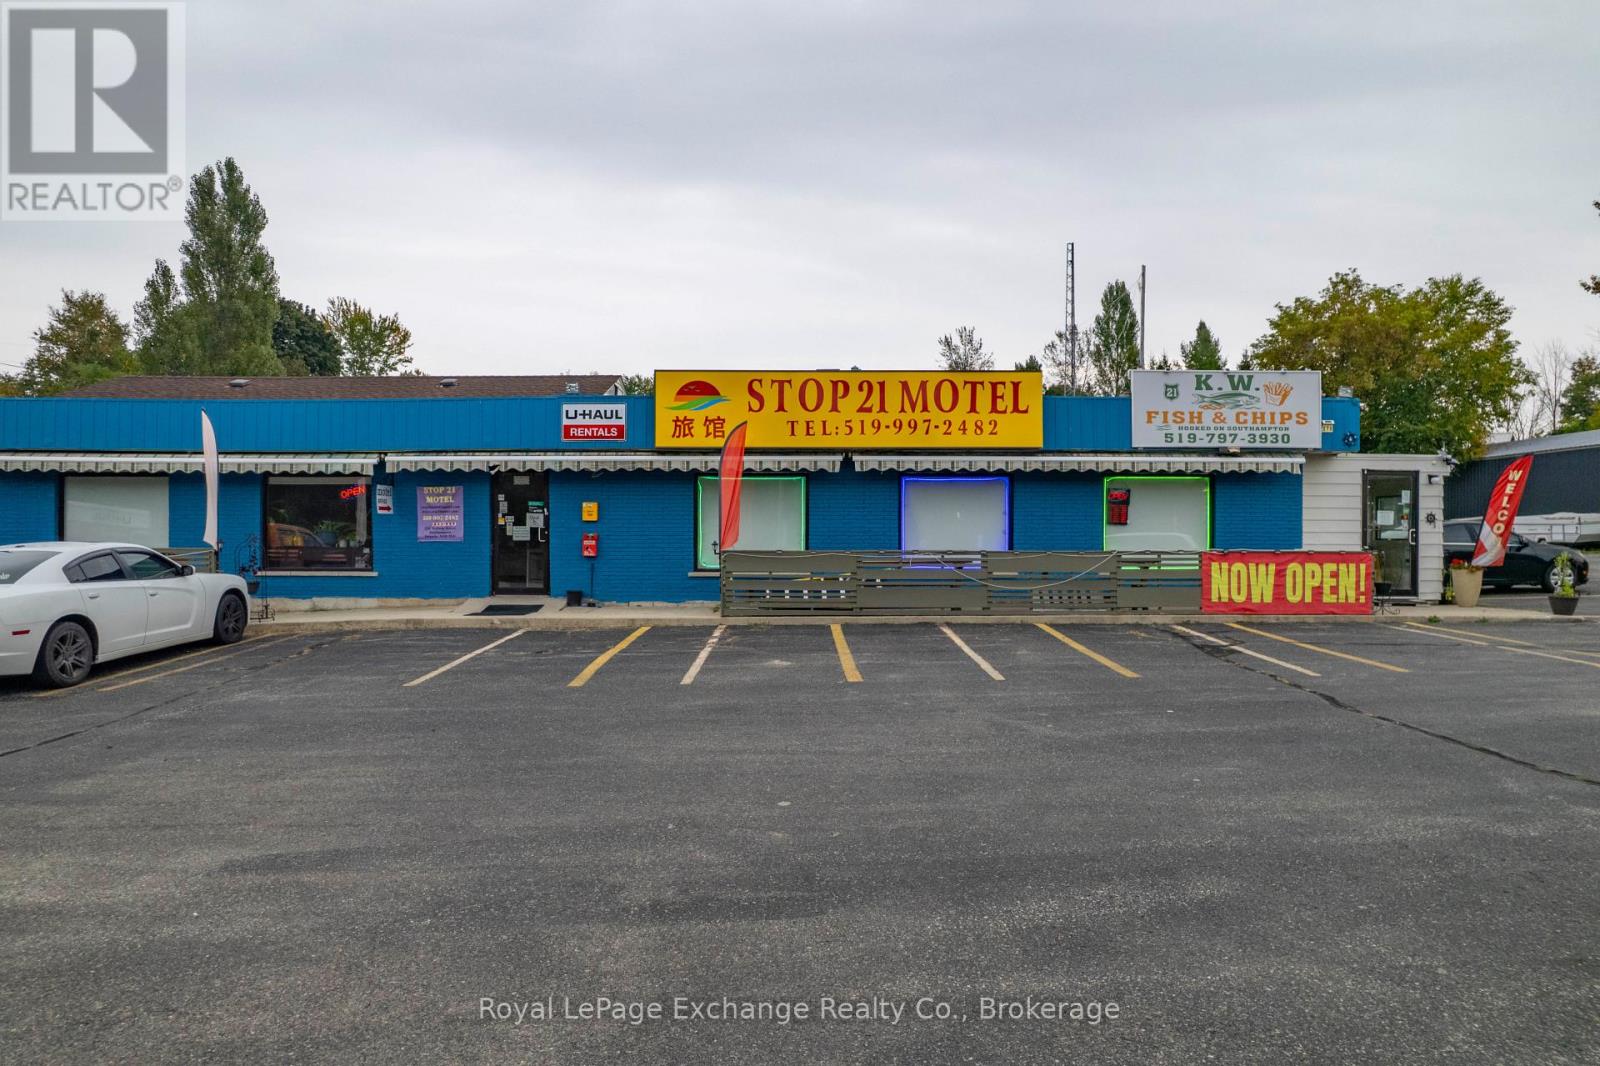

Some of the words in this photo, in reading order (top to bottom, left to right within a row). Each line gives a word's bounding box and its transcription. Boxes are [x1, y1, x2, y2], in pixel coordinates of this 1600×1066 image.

[748, 378, 850, 413] STOP
[860, 380, 888, 413] 21
[898, 380, 1029, 414] MOTEL
[1165, 387, 1177, 397] 21
[565, 409, 623, 420] U-HAUL
[1146, 411, 1203, 425] FISH
[1212, 412, 1227, 424] &
[1235, 411, 1308, 425] CHIPS
[570, 428, 618, 437] RENTALS
[672, 416, 726, 439] 旅馆
[1164, 433, 1291, 444] 519-797-3930
[340, 485, 366, 499] OPEN
[423, 486, 444, 494] STOP
[1211, 562, 1276, 604] NOW
[1286, 561, 1366, 604] OPEN!
